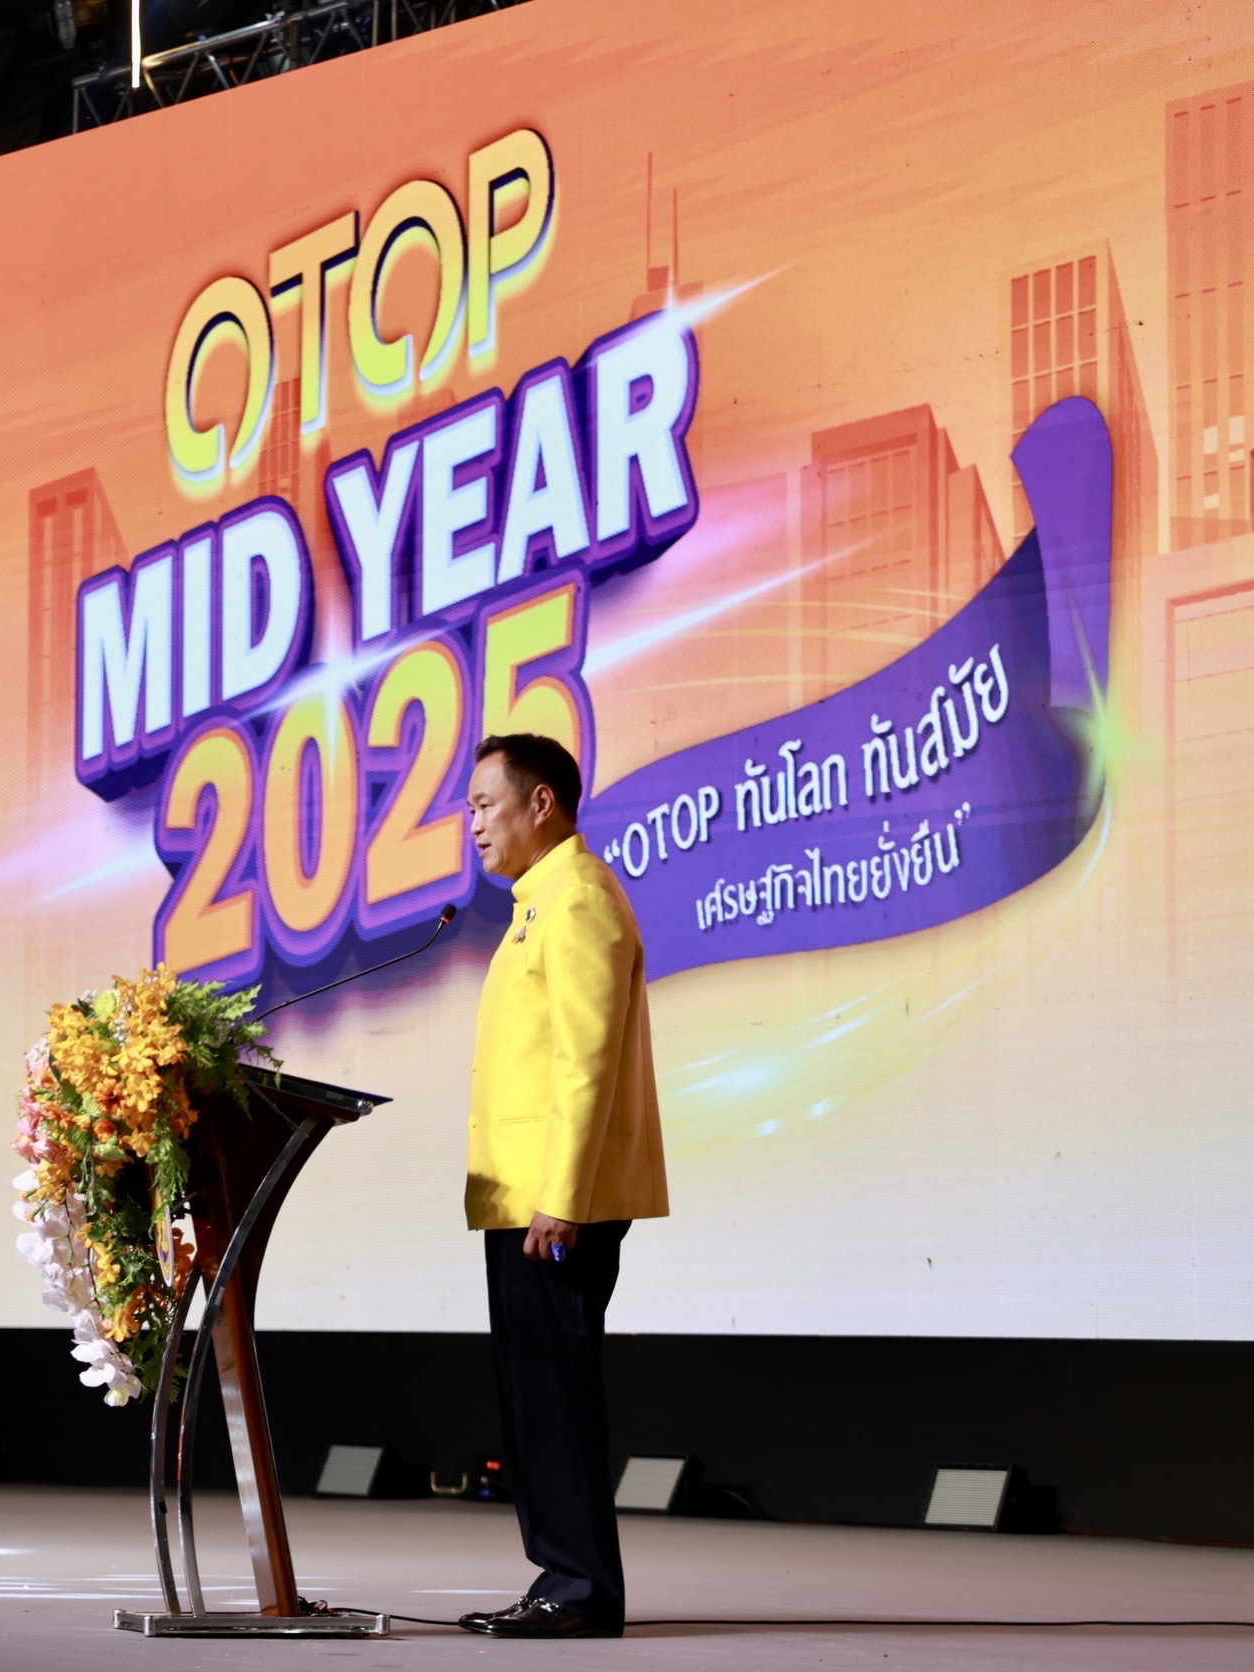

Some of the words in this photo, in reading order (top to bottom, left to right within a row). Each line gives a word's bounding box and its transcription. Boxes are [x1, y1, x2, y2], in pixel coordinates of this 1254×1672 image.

[165, 128, 555, 481] OTOP
[82, 510, 303, 761] MID
[333, 330, 689, 643] YEAR
[735, 739, 848, 831] ทันโลก
[862, 644, 1010, 797] ทันสมัย
